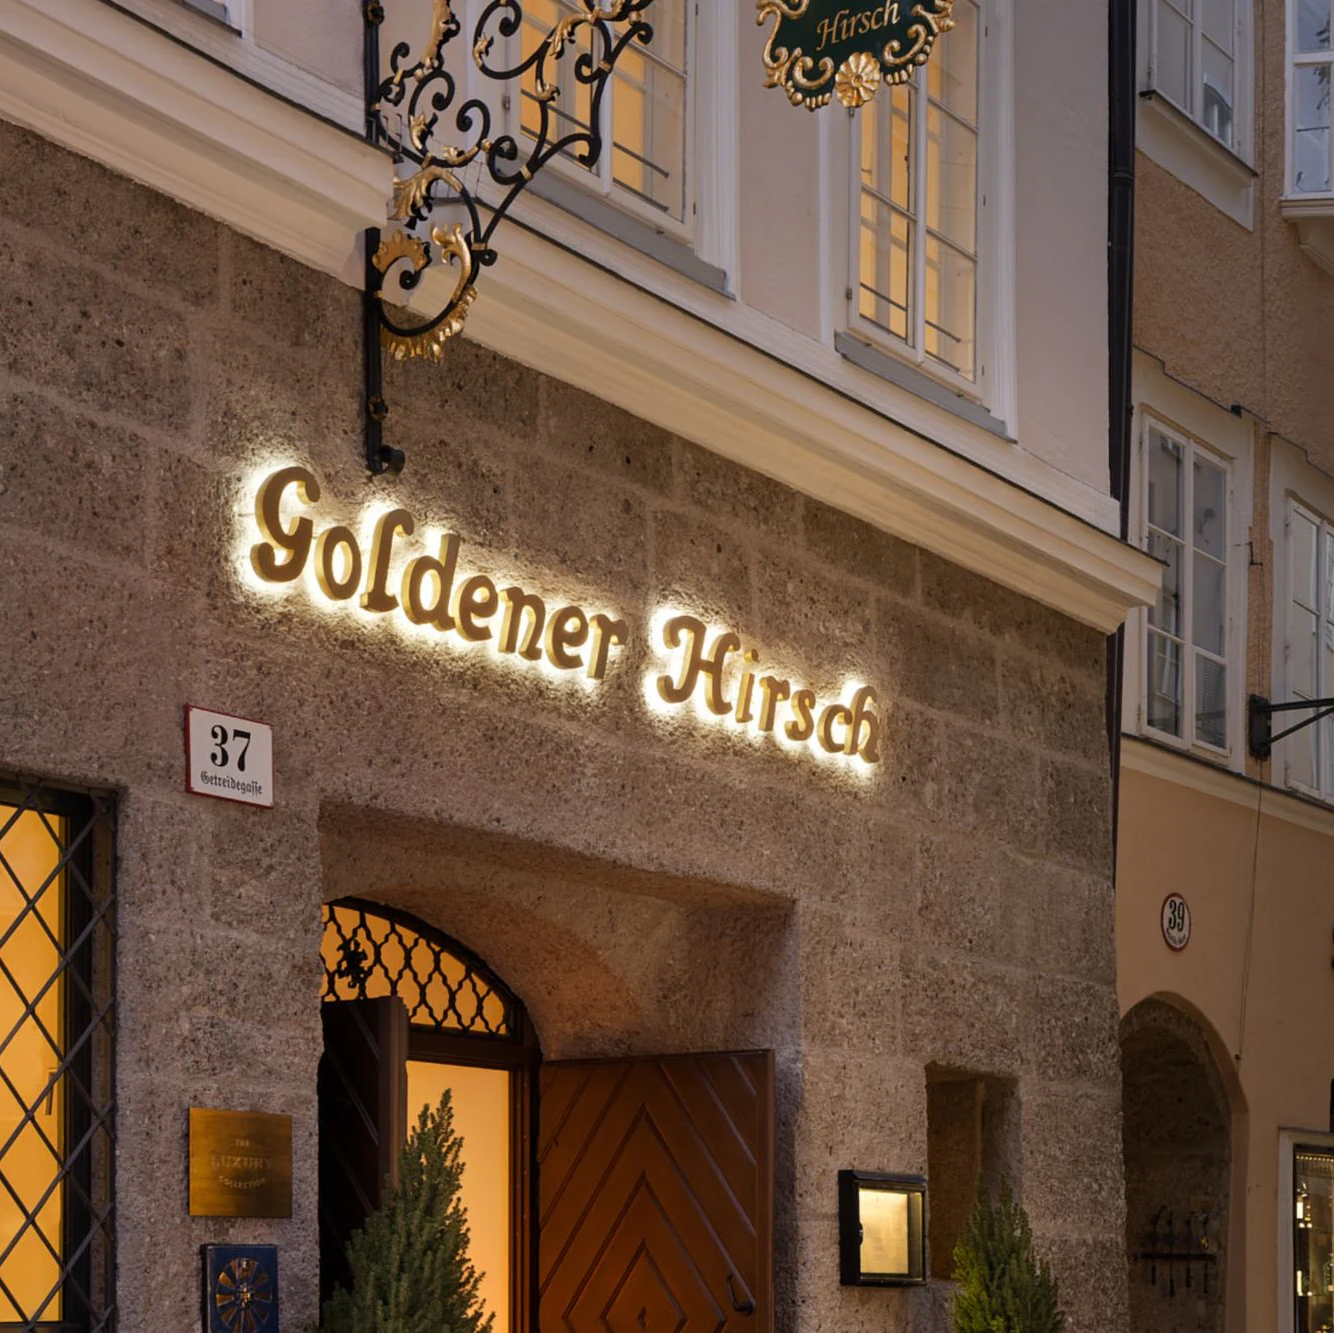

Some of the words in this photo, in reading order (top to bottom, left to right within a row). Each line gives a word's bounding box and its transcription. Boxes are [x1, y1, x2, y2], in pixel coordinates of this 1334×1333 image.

[815, 0, 901, 51] Hirsch
[250, 466, 628, 680] Goldener
[657, 615, 880, 764] Hirsch
[210, 724, 251, 772] 37
[1168, 899, 1185, 932] 39
